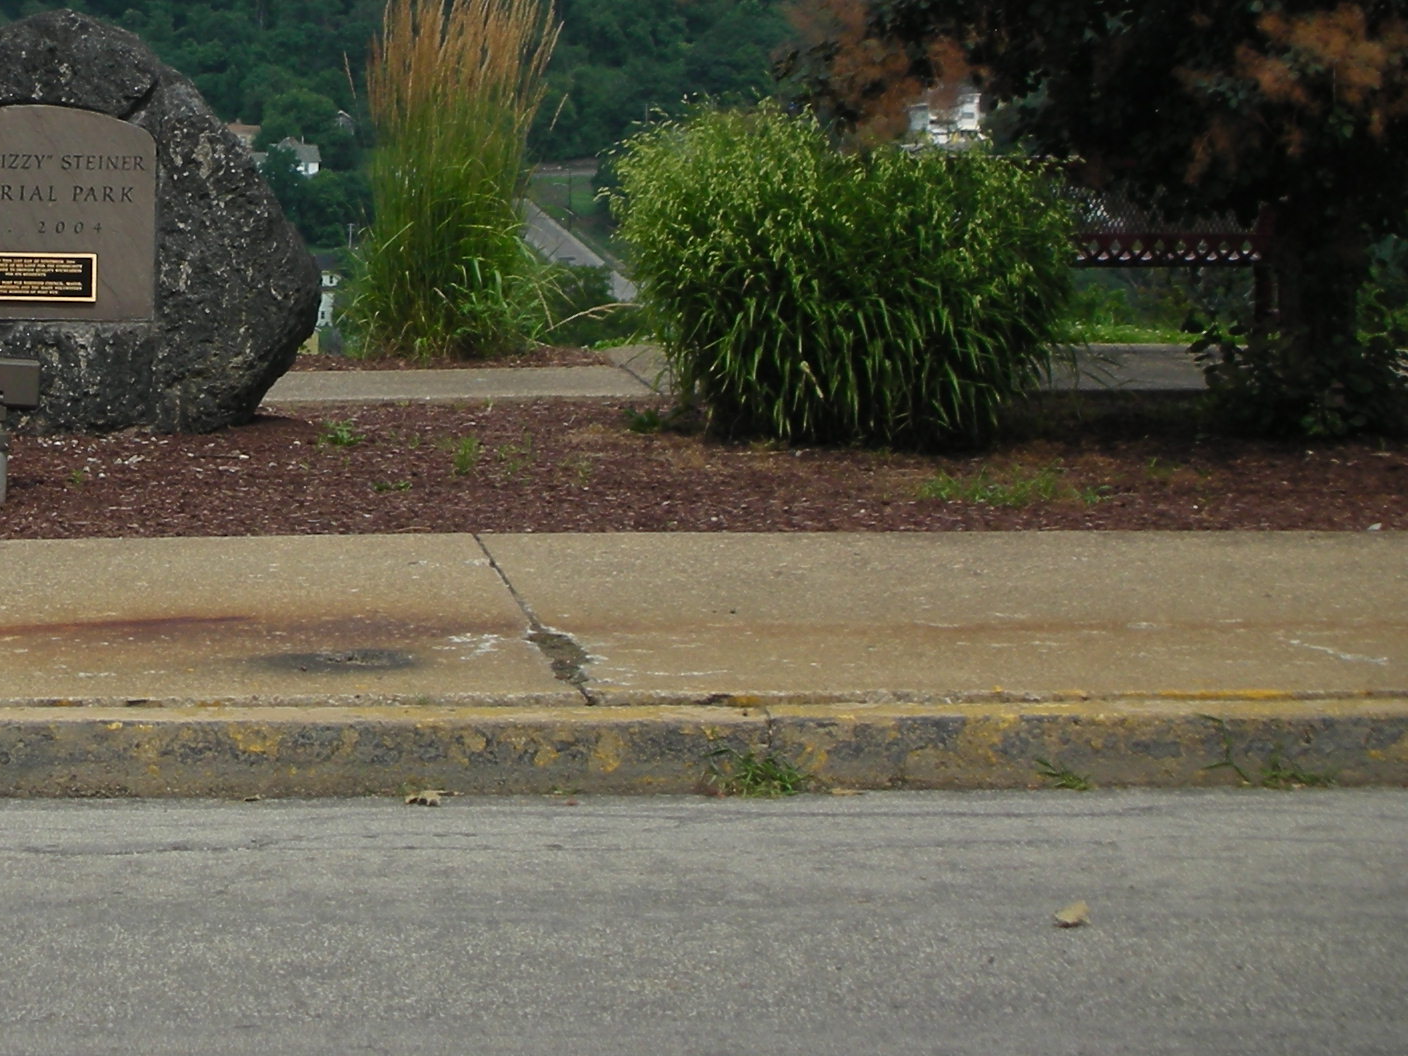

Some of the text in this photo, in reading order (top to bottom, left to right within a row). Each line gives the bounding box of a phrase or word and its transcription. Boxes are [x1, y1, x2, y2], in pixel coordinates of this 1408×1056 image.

[60, 154, 145, 171] STEINER
[72, 185, 133, 203] PARK
[38, 220, 102, 234] 2004
